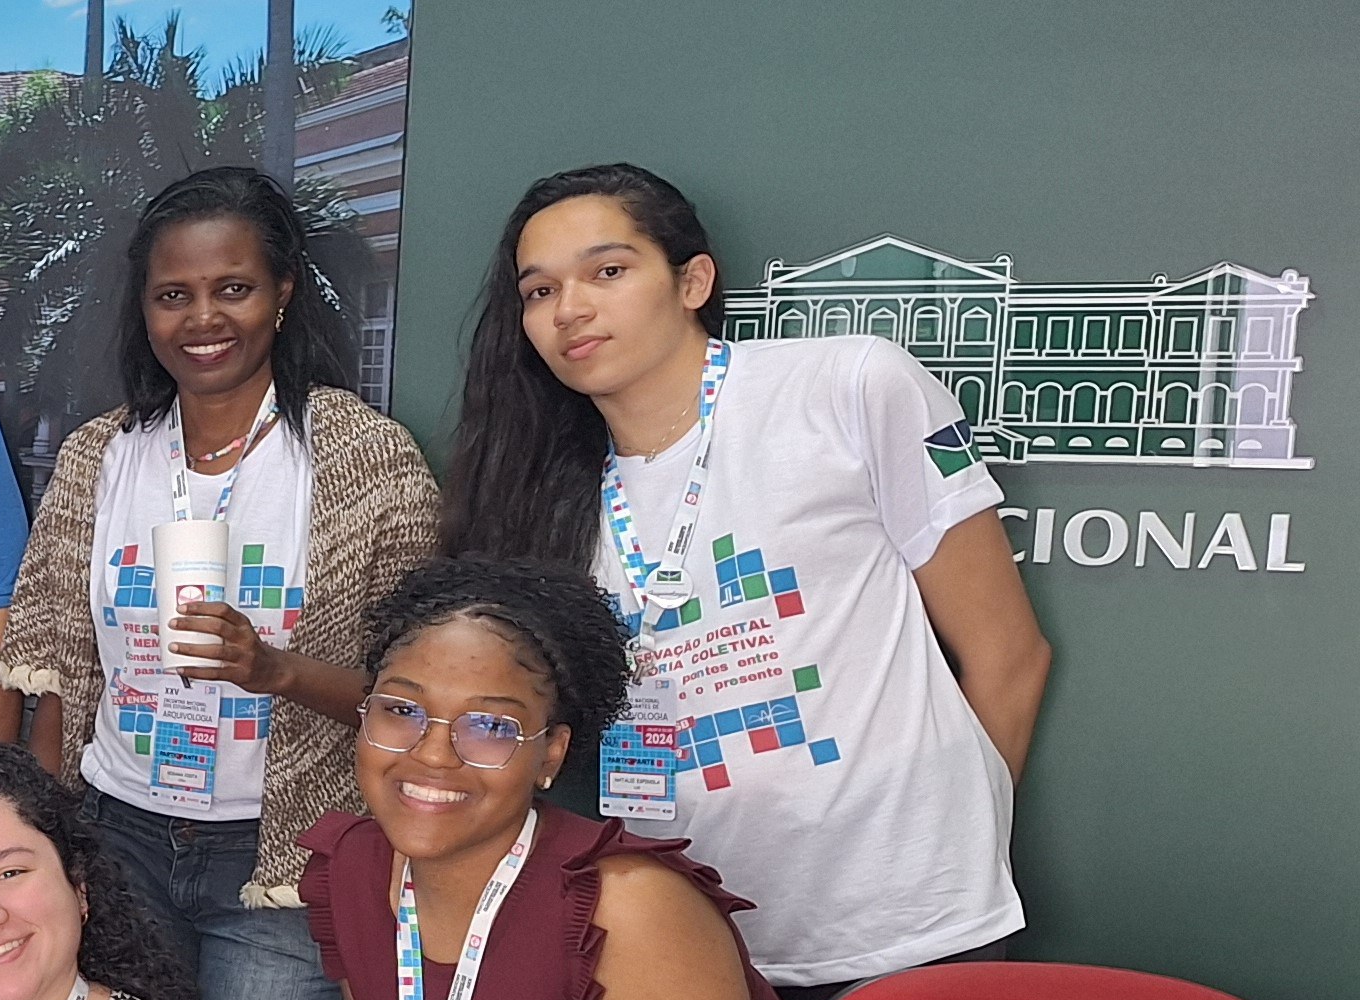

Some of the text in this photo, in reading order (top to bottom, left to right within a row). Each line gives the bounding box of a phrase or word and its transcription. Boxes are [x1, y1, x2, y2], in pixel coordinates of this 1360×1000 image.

[706, 617, 771, 644] DIGITAL
[692, 634, 776, 665] COLETIVA:
[682, 651, 779, 686] pontes entre
[714, 666, 783, 693] presente
[164, 687, 180, 696] XXV
[192, 732, 215, 744] 2024
[645, 732, 674, 745] 2024
